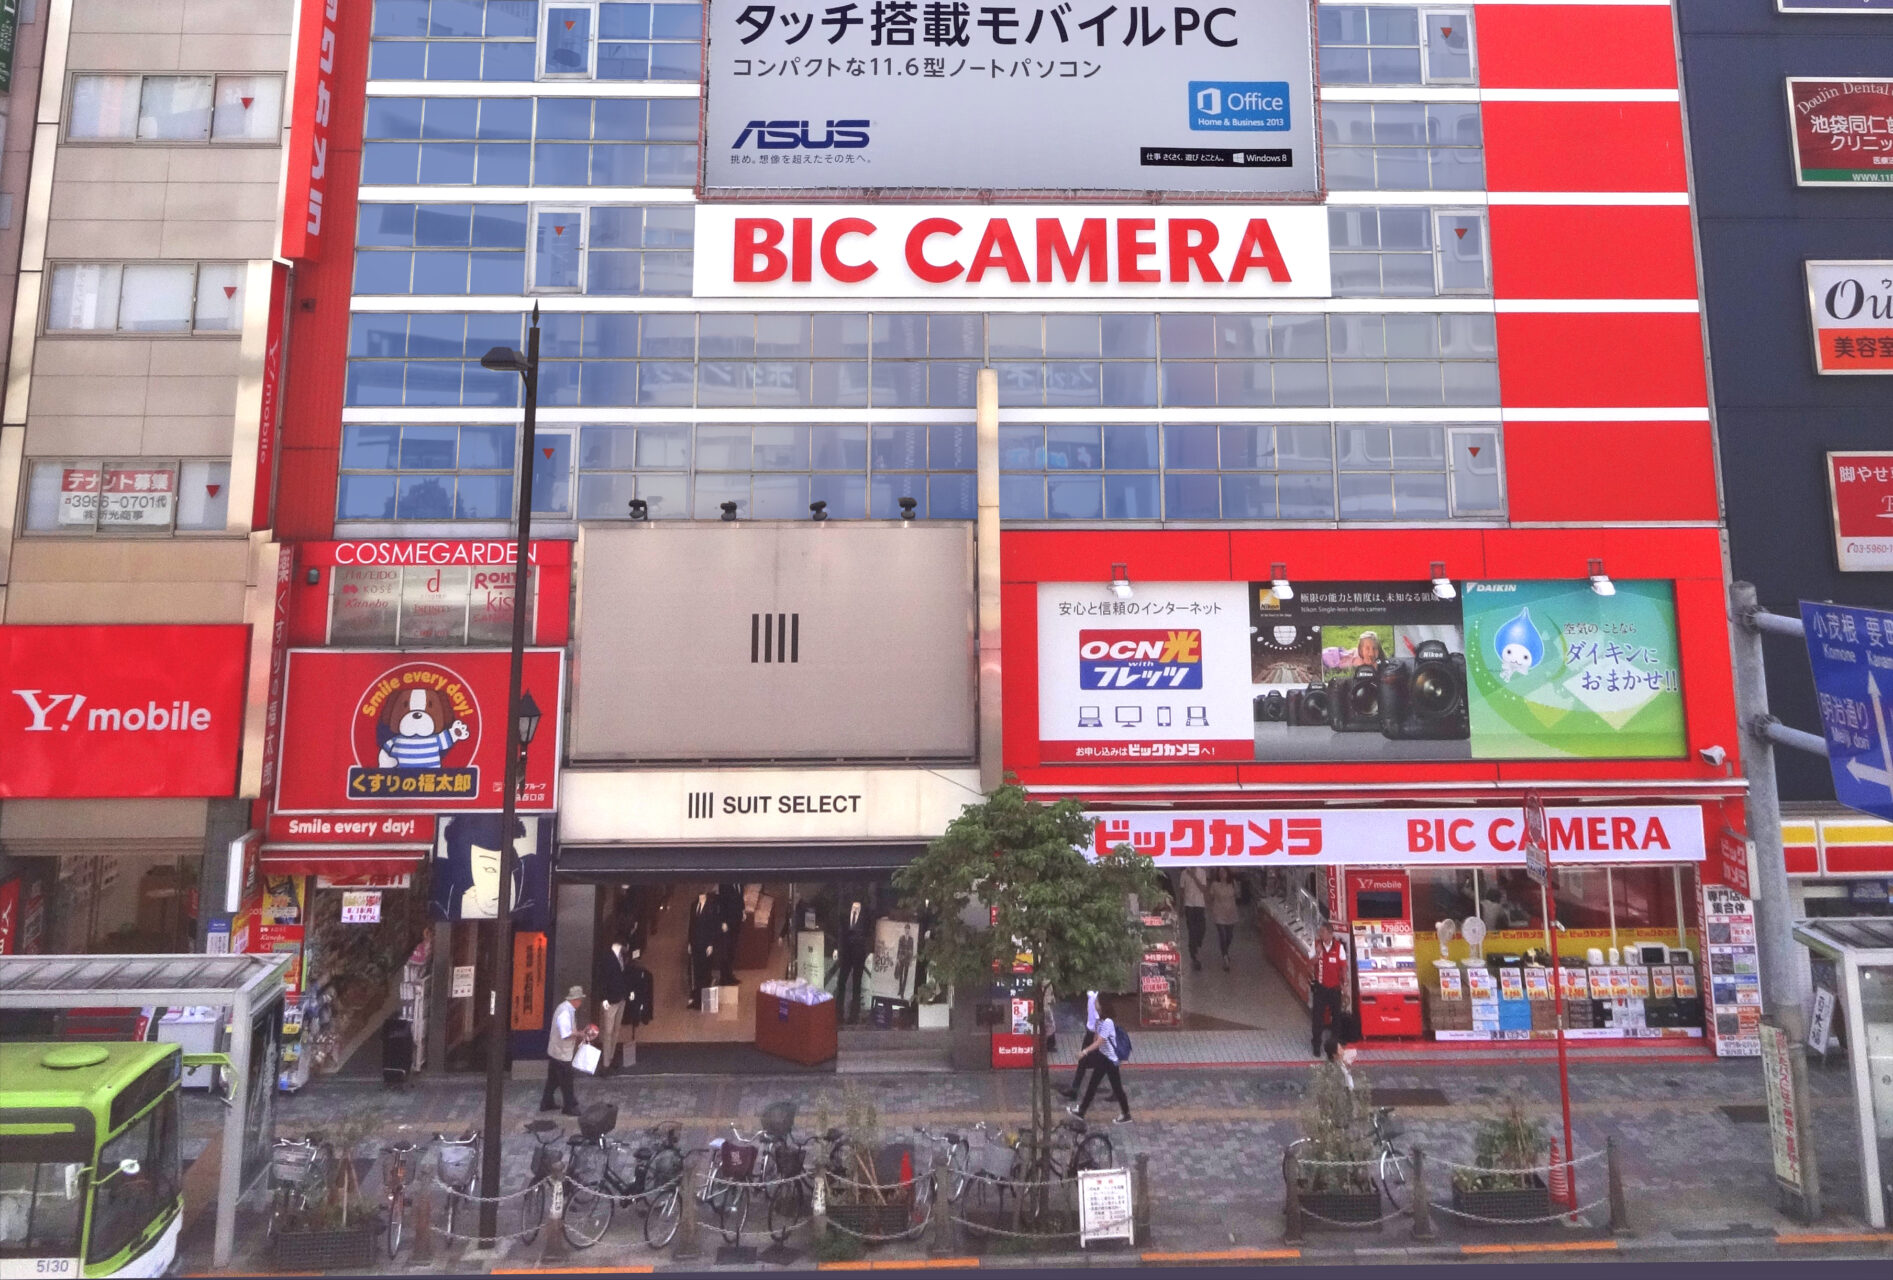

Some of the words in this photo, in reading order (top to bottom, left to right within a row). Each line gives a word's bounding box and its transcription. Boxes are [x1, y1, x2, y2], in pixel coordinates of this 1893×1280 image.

[735, 0, 1239, 47] タッチ搭載モバイルPC
[733, 57, 1102, 79] コンパクトな11.6型ノートパソコン
[1228, 92, 1284, 111] Office
[1797, 86, 1840, 115] Doujin
[1843, 82, 1889, 96] Dental
[1198, 118, 1222, 126] Home
[1223, 118, 1230, 126] &
[1232, 118, 1265, 127] Business
[1266, 118, 1284, 126] 2013
[731, 119, 871, 150] ASUS
[1246, 154, 1281, 163] Windows
[1281, 154, 1288, 162] 8
[733, 217, 878, 284] BIC
[904, 217, 1293, 284] CAMERA
[1834, 336, 1893, 358] 美容室
[68, 473, 168, 491] テナント募集
[335, 542, 537, 565] COSMEGARDEN
[427, 568, 441, 593] d
[1475, 584, 1517, 592] DAIKIN
[486, 590, 516, 612] kis
[1058, 601, 1222, 616] 安心と信頼のインターネット
[1813, 610, 1860, 645] 小茂根
[1422, 651, 1444, 659] Nikon
[1566, 641, 1659, 665] ダイキンに
[1822, 642, 1857, 664] Komone
[1094, 667, 1190, 687] フレッツ
[362, 676, 401, 718] Smile
[403, 671, 447, 691] every
[446, 683, 474, 717] day!
[1819, 691, 1870, 730] 明治通り
[353, 773, 472, 793] くすりの福太郎
[722, 795, 773, 815] SUIT
[778, 795, 862, 814] SELECT
[288, 818, 331, 835] Smile
[334, 820, 377, 837] every
[382, 818, 415, 837] day!
[1095, 819, 1323, 857] ビックカメラ
[1407, 818, 1475, 853] BIC
[1488, 816, 1671, 852] CAMERA
